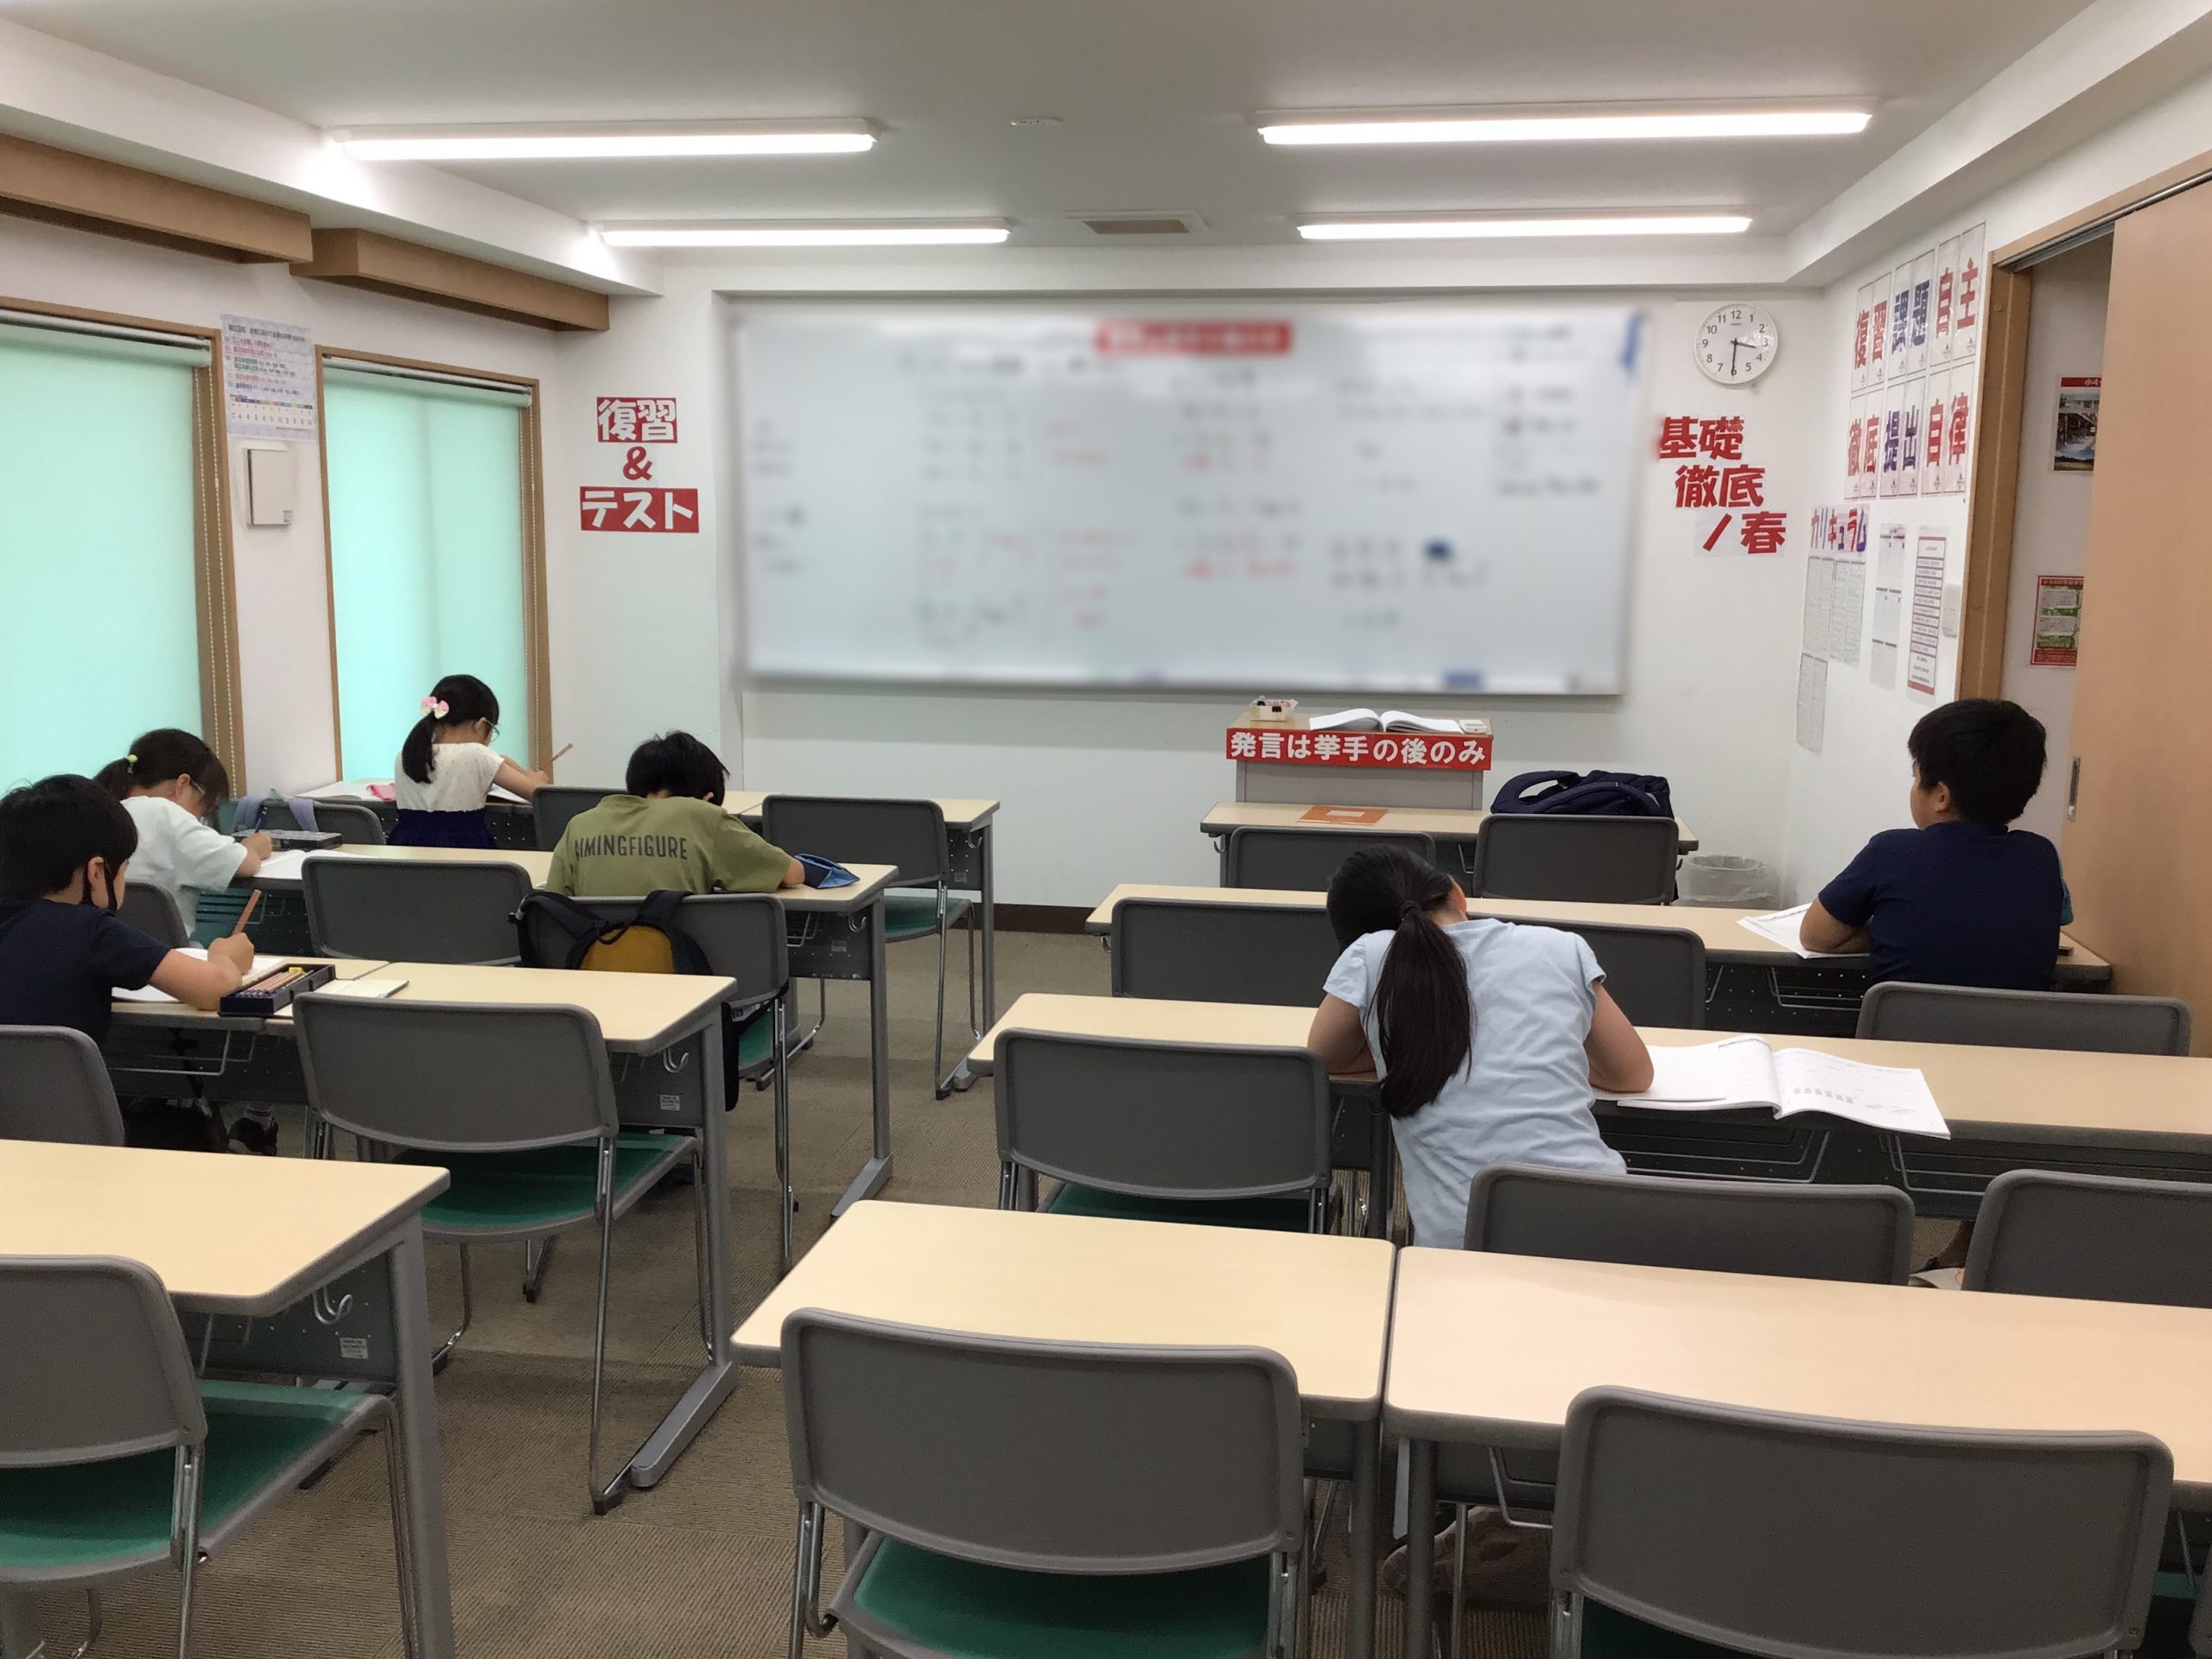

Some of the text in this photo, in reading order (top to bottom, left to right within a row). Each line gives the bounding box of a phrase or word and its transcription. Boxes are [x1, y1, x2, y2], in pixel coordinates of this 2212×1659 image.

[1718, 315, 1726, 323] 11
[1731, 310, 1741, 320] 12
[1750, 314, 1754, 323] 1
[1707, 325, 1718, 334] 10
[1758, 323, 1764, 333] 2
[1701, 339, 1708, 347] 9
[1763, 338, 1769, 346] 3
[1706, 353, 1713, 363] 8
[1756, 353, 1763, 361] 4
[1717, 363, 1724, 372] 7
[1745, 362, 1751, 372] 5
[597, 399, 677, 442] 復習
[1658, 416, 1745, 460] 基礎
[623, 446, 653, 481] &
[1675, 464, 1765, 507] 徹底
[582, 491, 694, 530] テスト
[1811, 508, 1867, 553] カリキュラム
[1230, 732, 1486, 765] 発言は挙手の後のみ
